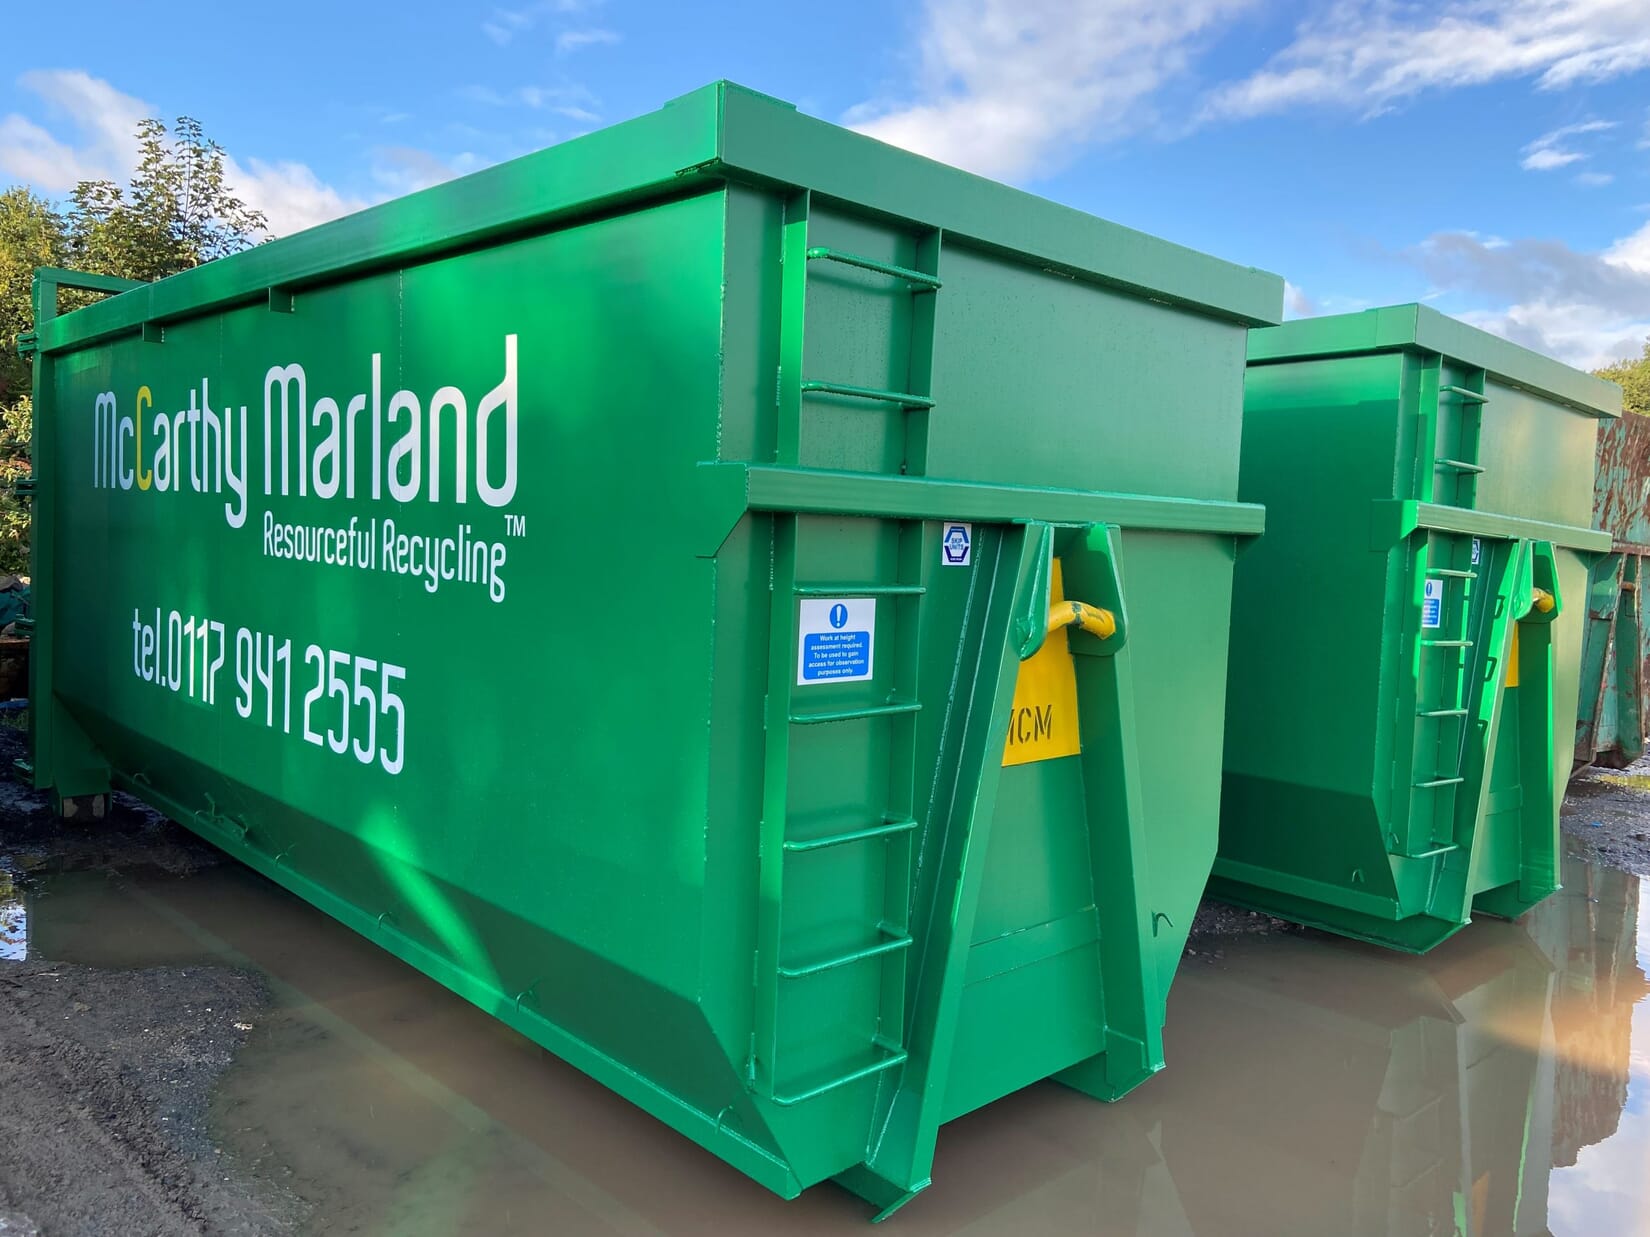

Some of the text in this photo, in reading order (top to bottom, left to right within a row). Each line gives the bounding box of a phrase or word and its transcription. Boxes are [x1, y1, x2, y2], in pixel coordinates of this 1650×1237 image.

[94, 334, 518, 528] McCarthy Marland
[264, 510, 506, 603] Resourceful Recycling
[236, 627, 291, 733] 941
[304, 644, 406, 775] 2555
[818, 669, 840, 677] purposes
